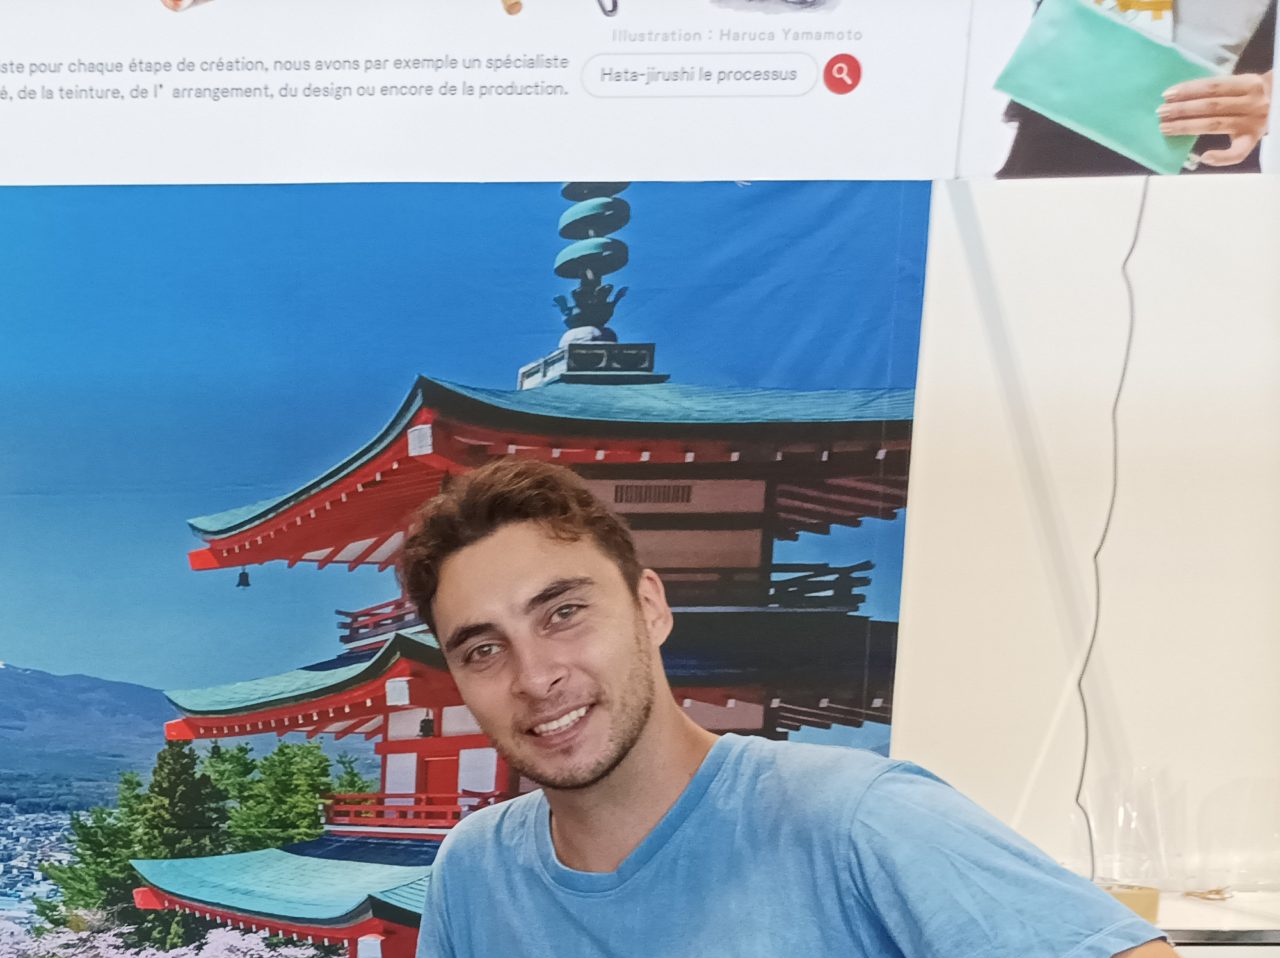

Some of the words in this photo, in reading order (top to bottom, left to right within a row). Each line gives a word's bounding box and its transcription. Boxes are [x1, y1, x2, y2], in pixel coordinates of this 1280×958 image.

[612, 28, 702, 43] Illustration
[719, 28, 775, 42] Haruca
[782, 27, 863, 42] Yamamoto
[28, 61, 64, 78] pour
[67, 58, 124, 77] chaque
[128, 57, 173, 76] étape
[176, 57, 196, 73] de
[199, 56, 270, 74] création,
[273, 58, 311, 72] nous
[314, 58, 361, 72] avons
[363, 58, 390, 74] par
[392, 54, 459, 73] exemple
[462, 57, 482, 71] un
[485, 53, 570, 74] spécialiste
[599, 66, 695, 86] Hata-jirushi
[698, 66, 713, 82] le
[716, 67, 798, 85] processus
[17, 85, 38, 100] de
[41, 84, 54, 100] la
[57, 84, 125, 101] teinture,
[129, 83, 149, 100] de
[171, 84, 275, 102] arrangement,
[278, 82, 298, 98] du
[302, 80, 353, 101] design
[356, 83, 376, 97] ou
[379, 82, 434, 97] encore
[438, 80, 458, 96] de
[462, 80, 475, 96] la
[478, 79, 569, 99] production.
